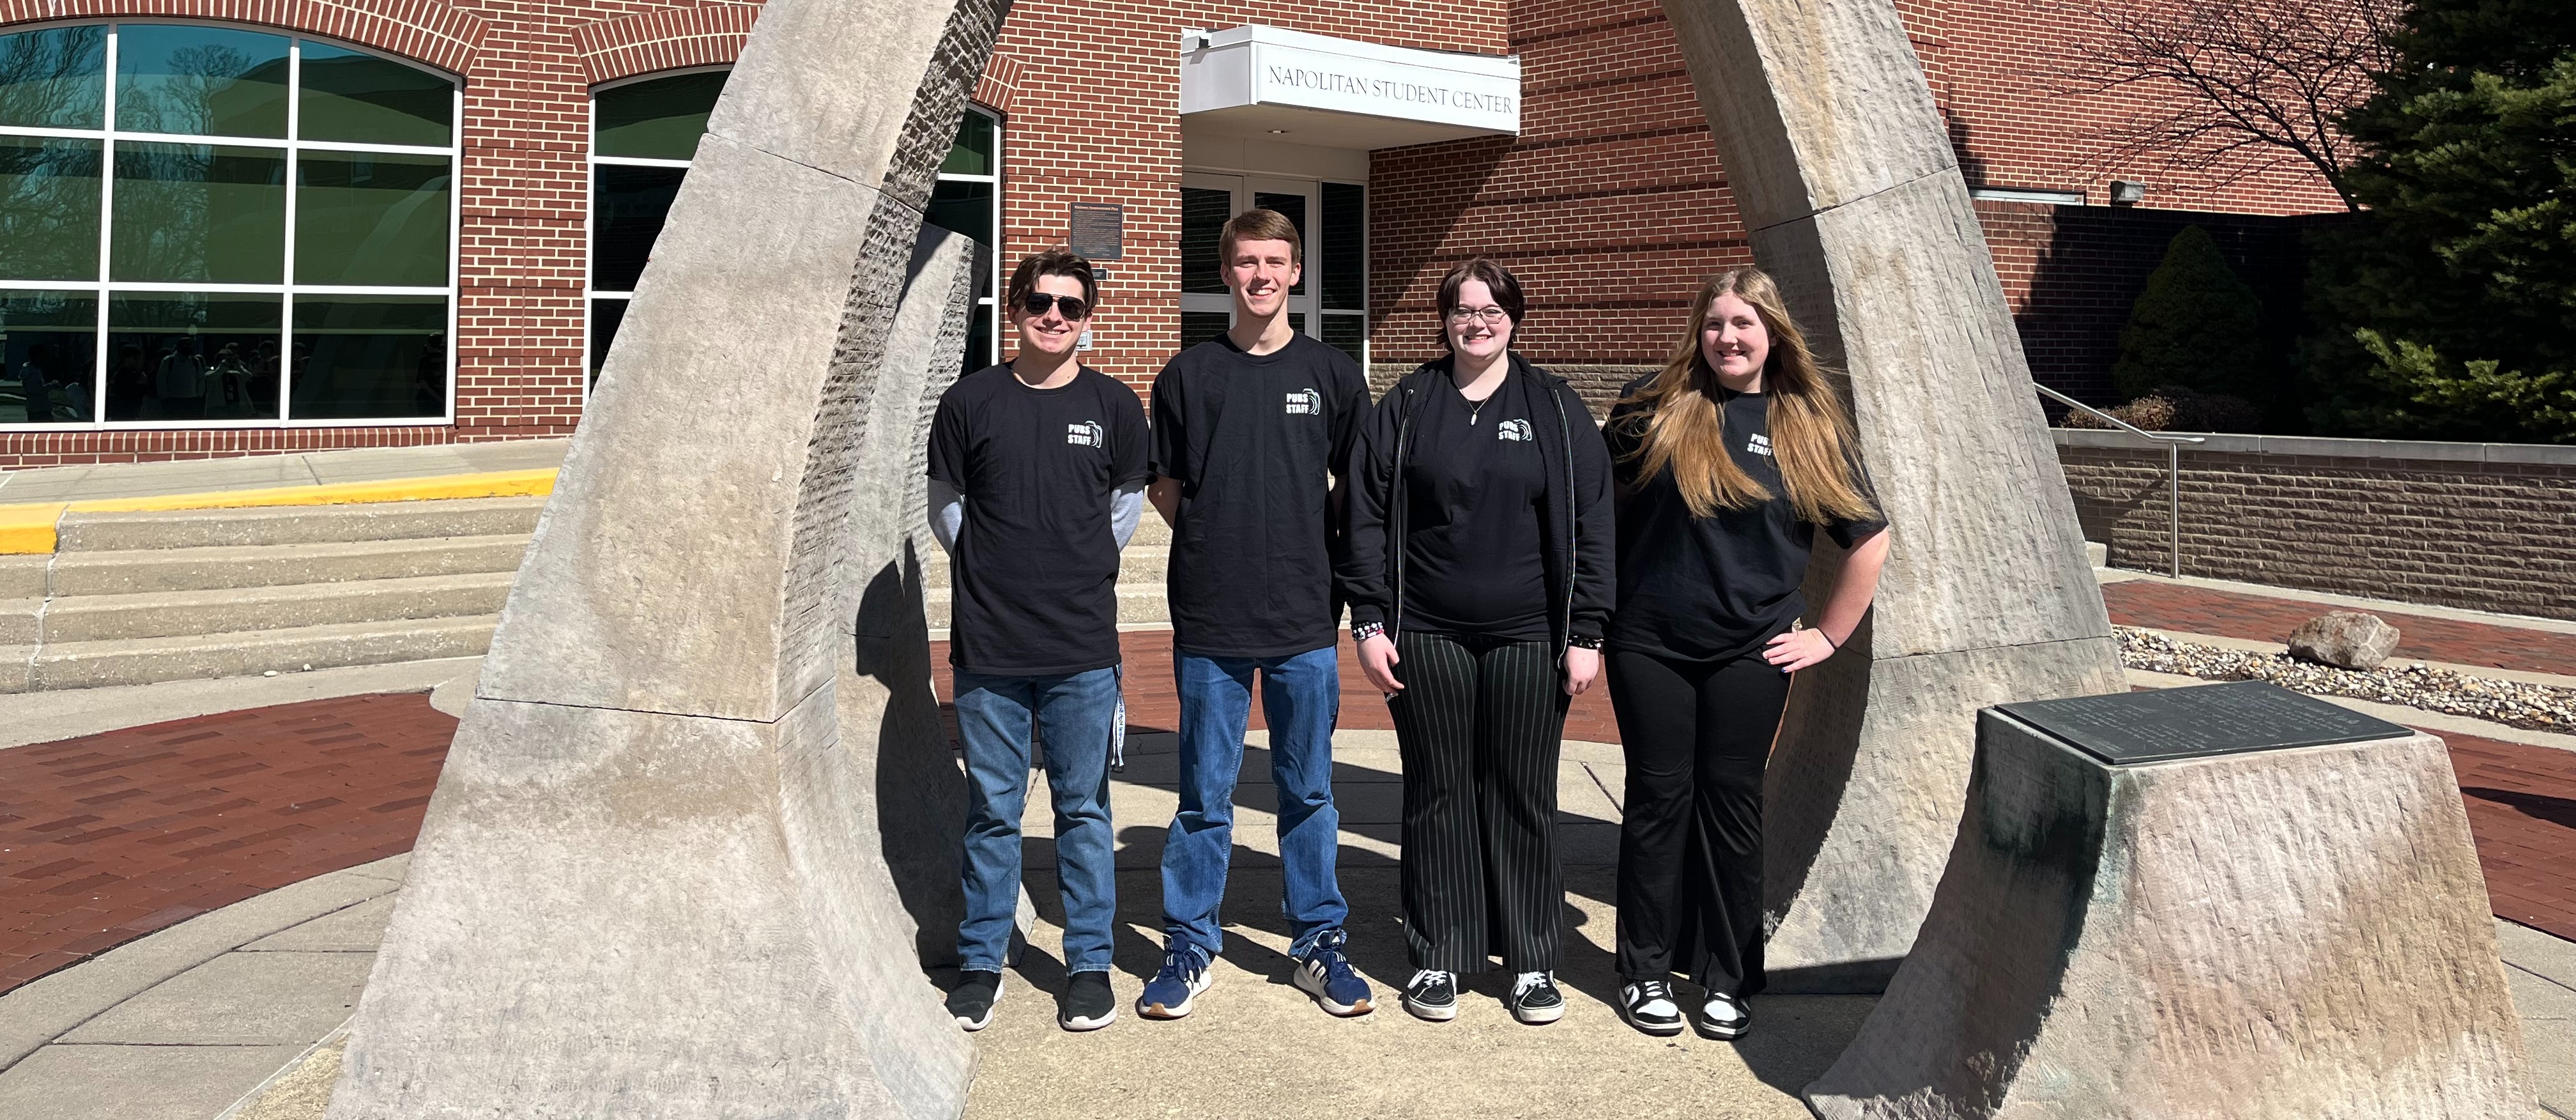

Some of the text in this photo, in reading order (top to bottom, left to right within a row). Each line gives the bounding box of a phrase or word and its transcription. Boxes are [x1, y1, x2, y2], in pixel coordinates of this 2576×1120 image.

[1269, 65, 1514, 114] NAPOLITAN STUDENT CENTER
[1287, 393, 1308, 403] PUBS
[1286, 404, 1309, 414] STAFF
[1068, 424, 1091, 434] PUBS
[1499, 420, 1519, 432] PUBS
[1068, 434, 1091, 445] STAFF
[1498, 431, 1520, 441] STAFF
[1751, 433, 1769, 446] PUB
[1747, 443, 1772, 456] STAFF
